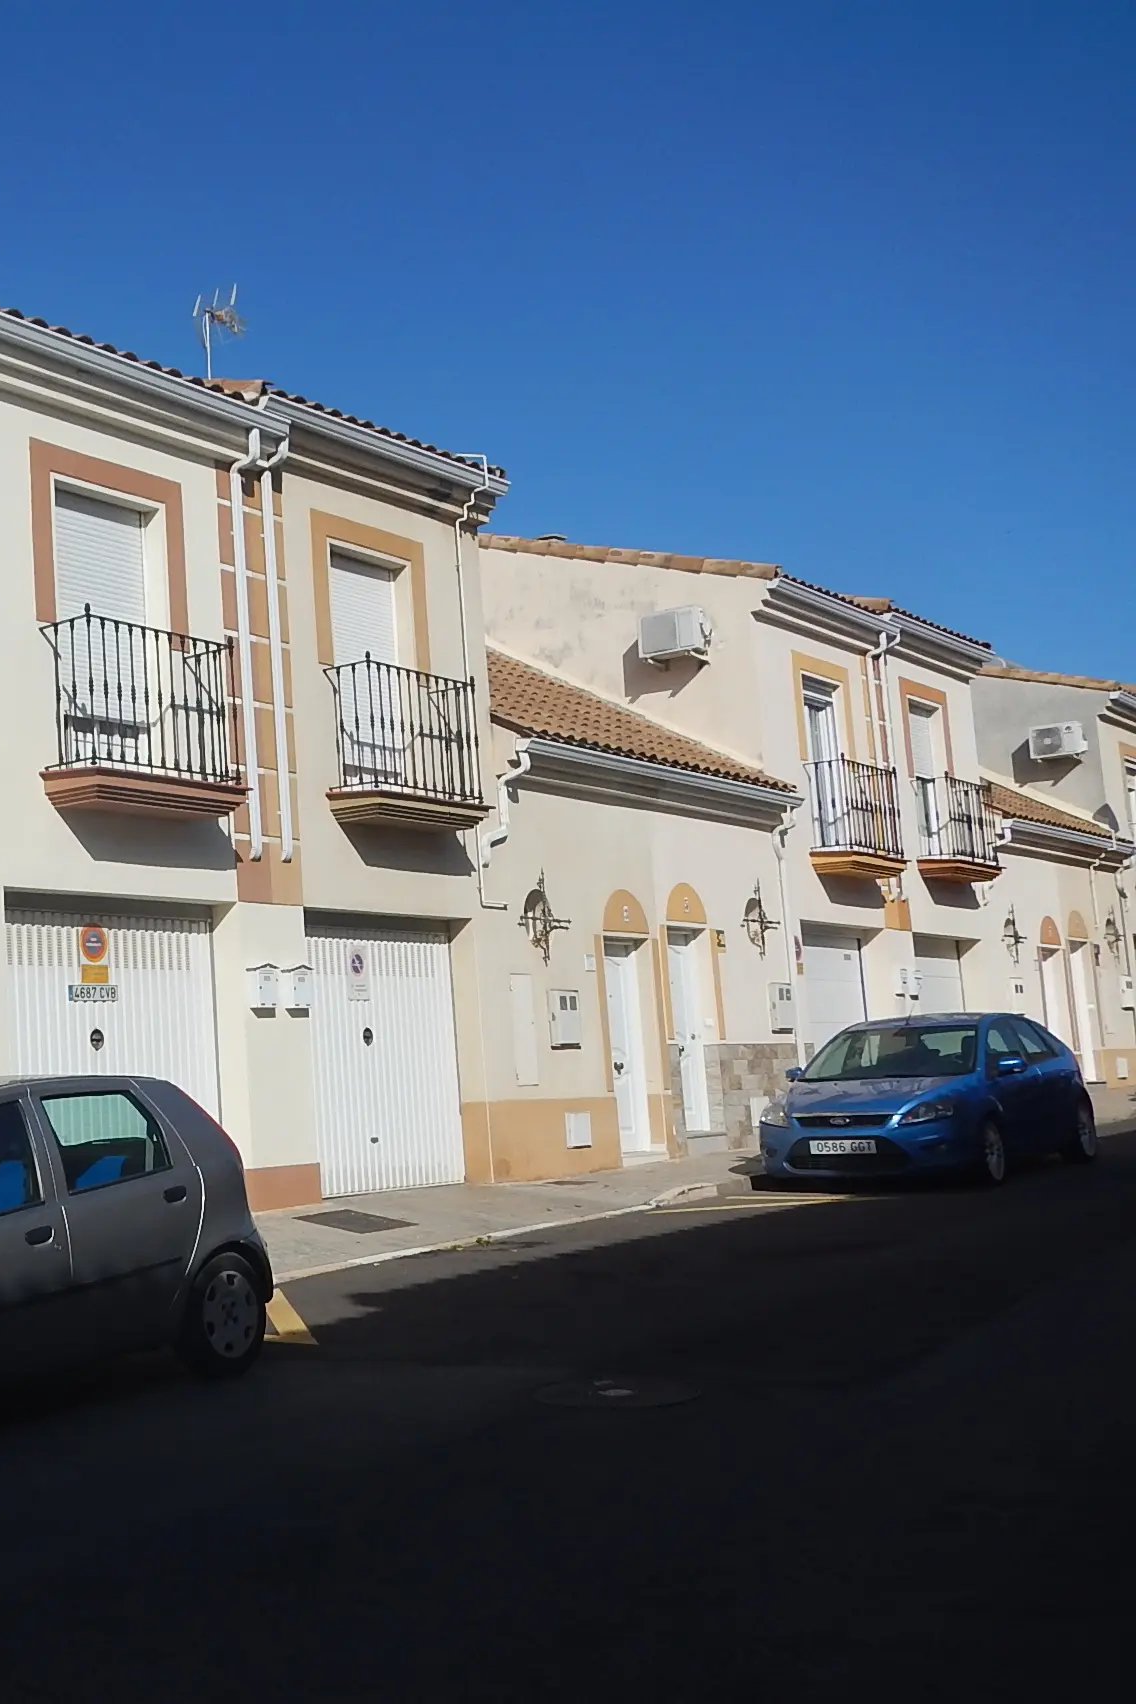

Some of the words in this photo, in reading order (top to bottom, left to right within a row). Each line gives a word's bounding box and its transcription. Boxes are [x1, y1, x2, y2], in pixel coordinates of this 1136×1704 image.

[74, 986, 97, 999] 4687
[99, 986, 116, 999] CVB
[816, 1141, 846, 1153] 0586
[850, 1141, 872, 1152] GGT
